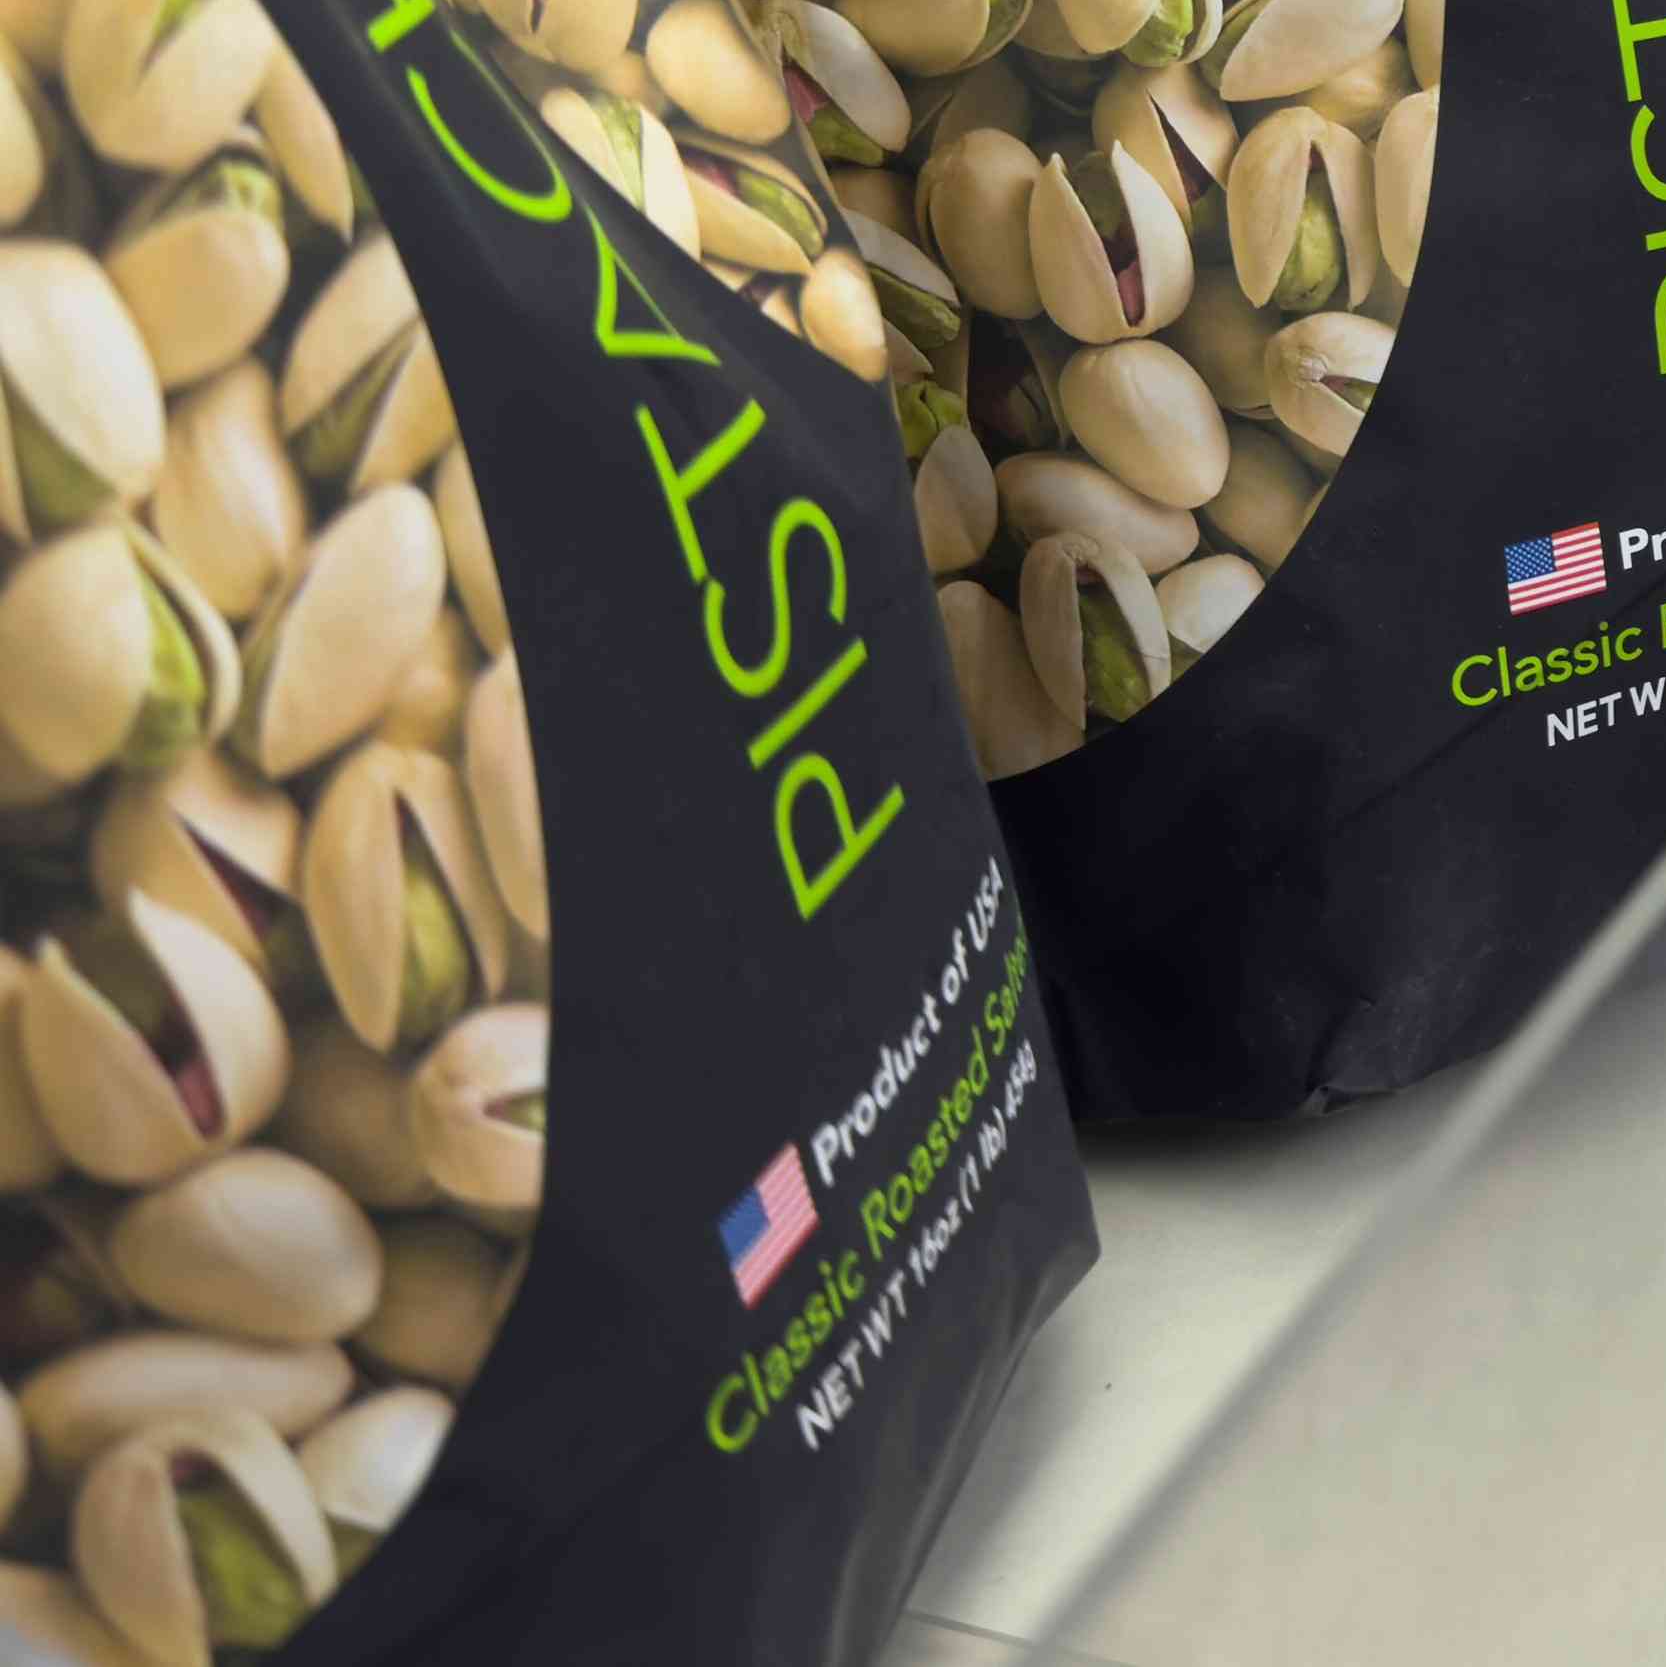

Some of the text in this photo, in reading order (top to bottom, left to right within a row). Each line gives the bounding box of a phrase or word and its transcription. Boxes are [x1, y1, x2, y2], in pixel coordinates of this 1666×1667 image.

[1450, 621, 1644, 707] Classic
[1546, 691, 1622, 747] NET
[811, 855, 1005, 1189] Product of USA
[706, 1248, 866, 1454] Classic
[860, 1023, 990, 1262] Roasted
[796, 1337, 865, 1452] NET
[860, 1267, 908, 1359] WT
[908, 1197, 963, 1287] 16oz
